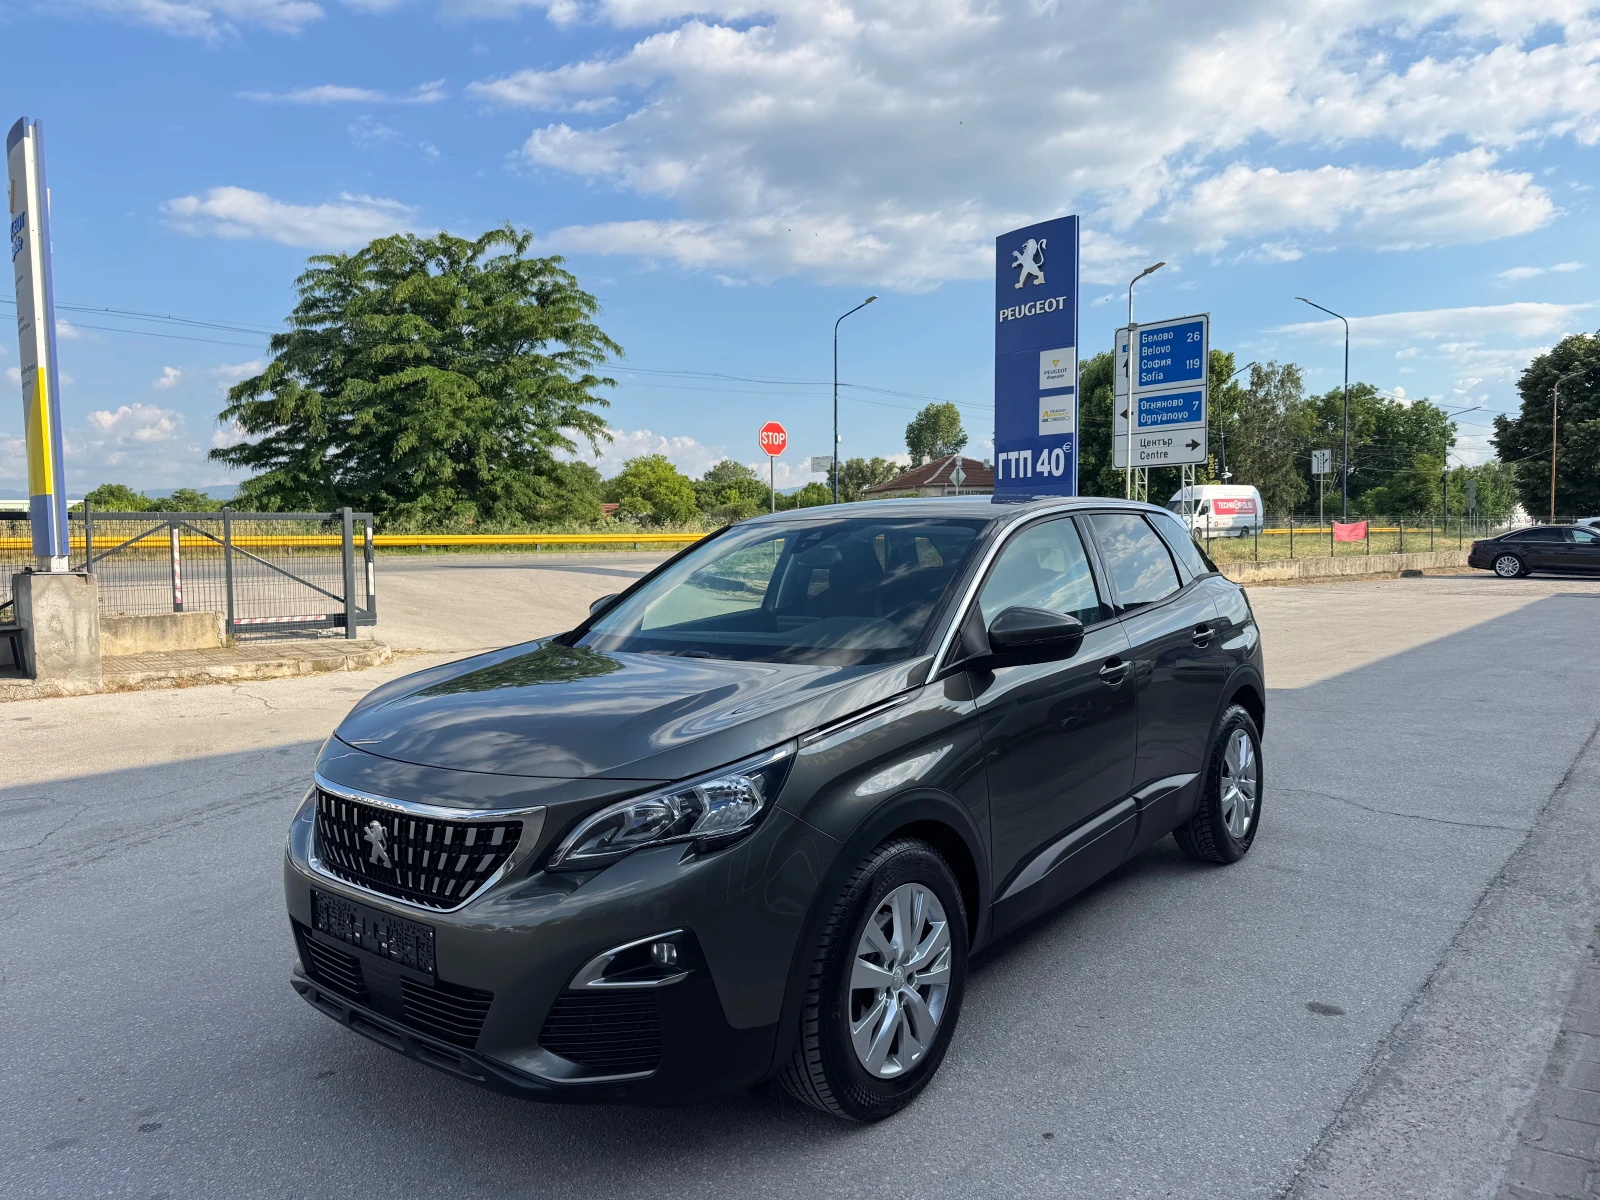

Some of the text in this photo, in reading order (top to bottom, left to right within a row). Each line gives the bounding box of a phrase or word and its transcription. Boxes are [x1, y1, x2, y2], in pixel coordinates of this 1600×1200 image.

[1000, 296, 1067, 323] PEUGEOT
[1142, 331, 1200, 344] Белово 26
[1142, 345, 1171, 357] Belovo
[1141, 358, 1200, 370] София 119
[1043, 367, 1068, 376] PEUGEOT
[1141, 371, 1164, 382] Sofia
[1140, 398, 1200, 411] Огняново 7
[1140, 411, 1188, 425] Ognyanovo
[762, 431, 786, 446] STOP
[1140, 438, 1173, 449] Център
[1139, 451, 1169, 460] Centre
[998, 450, 1032, 480] ГТП
